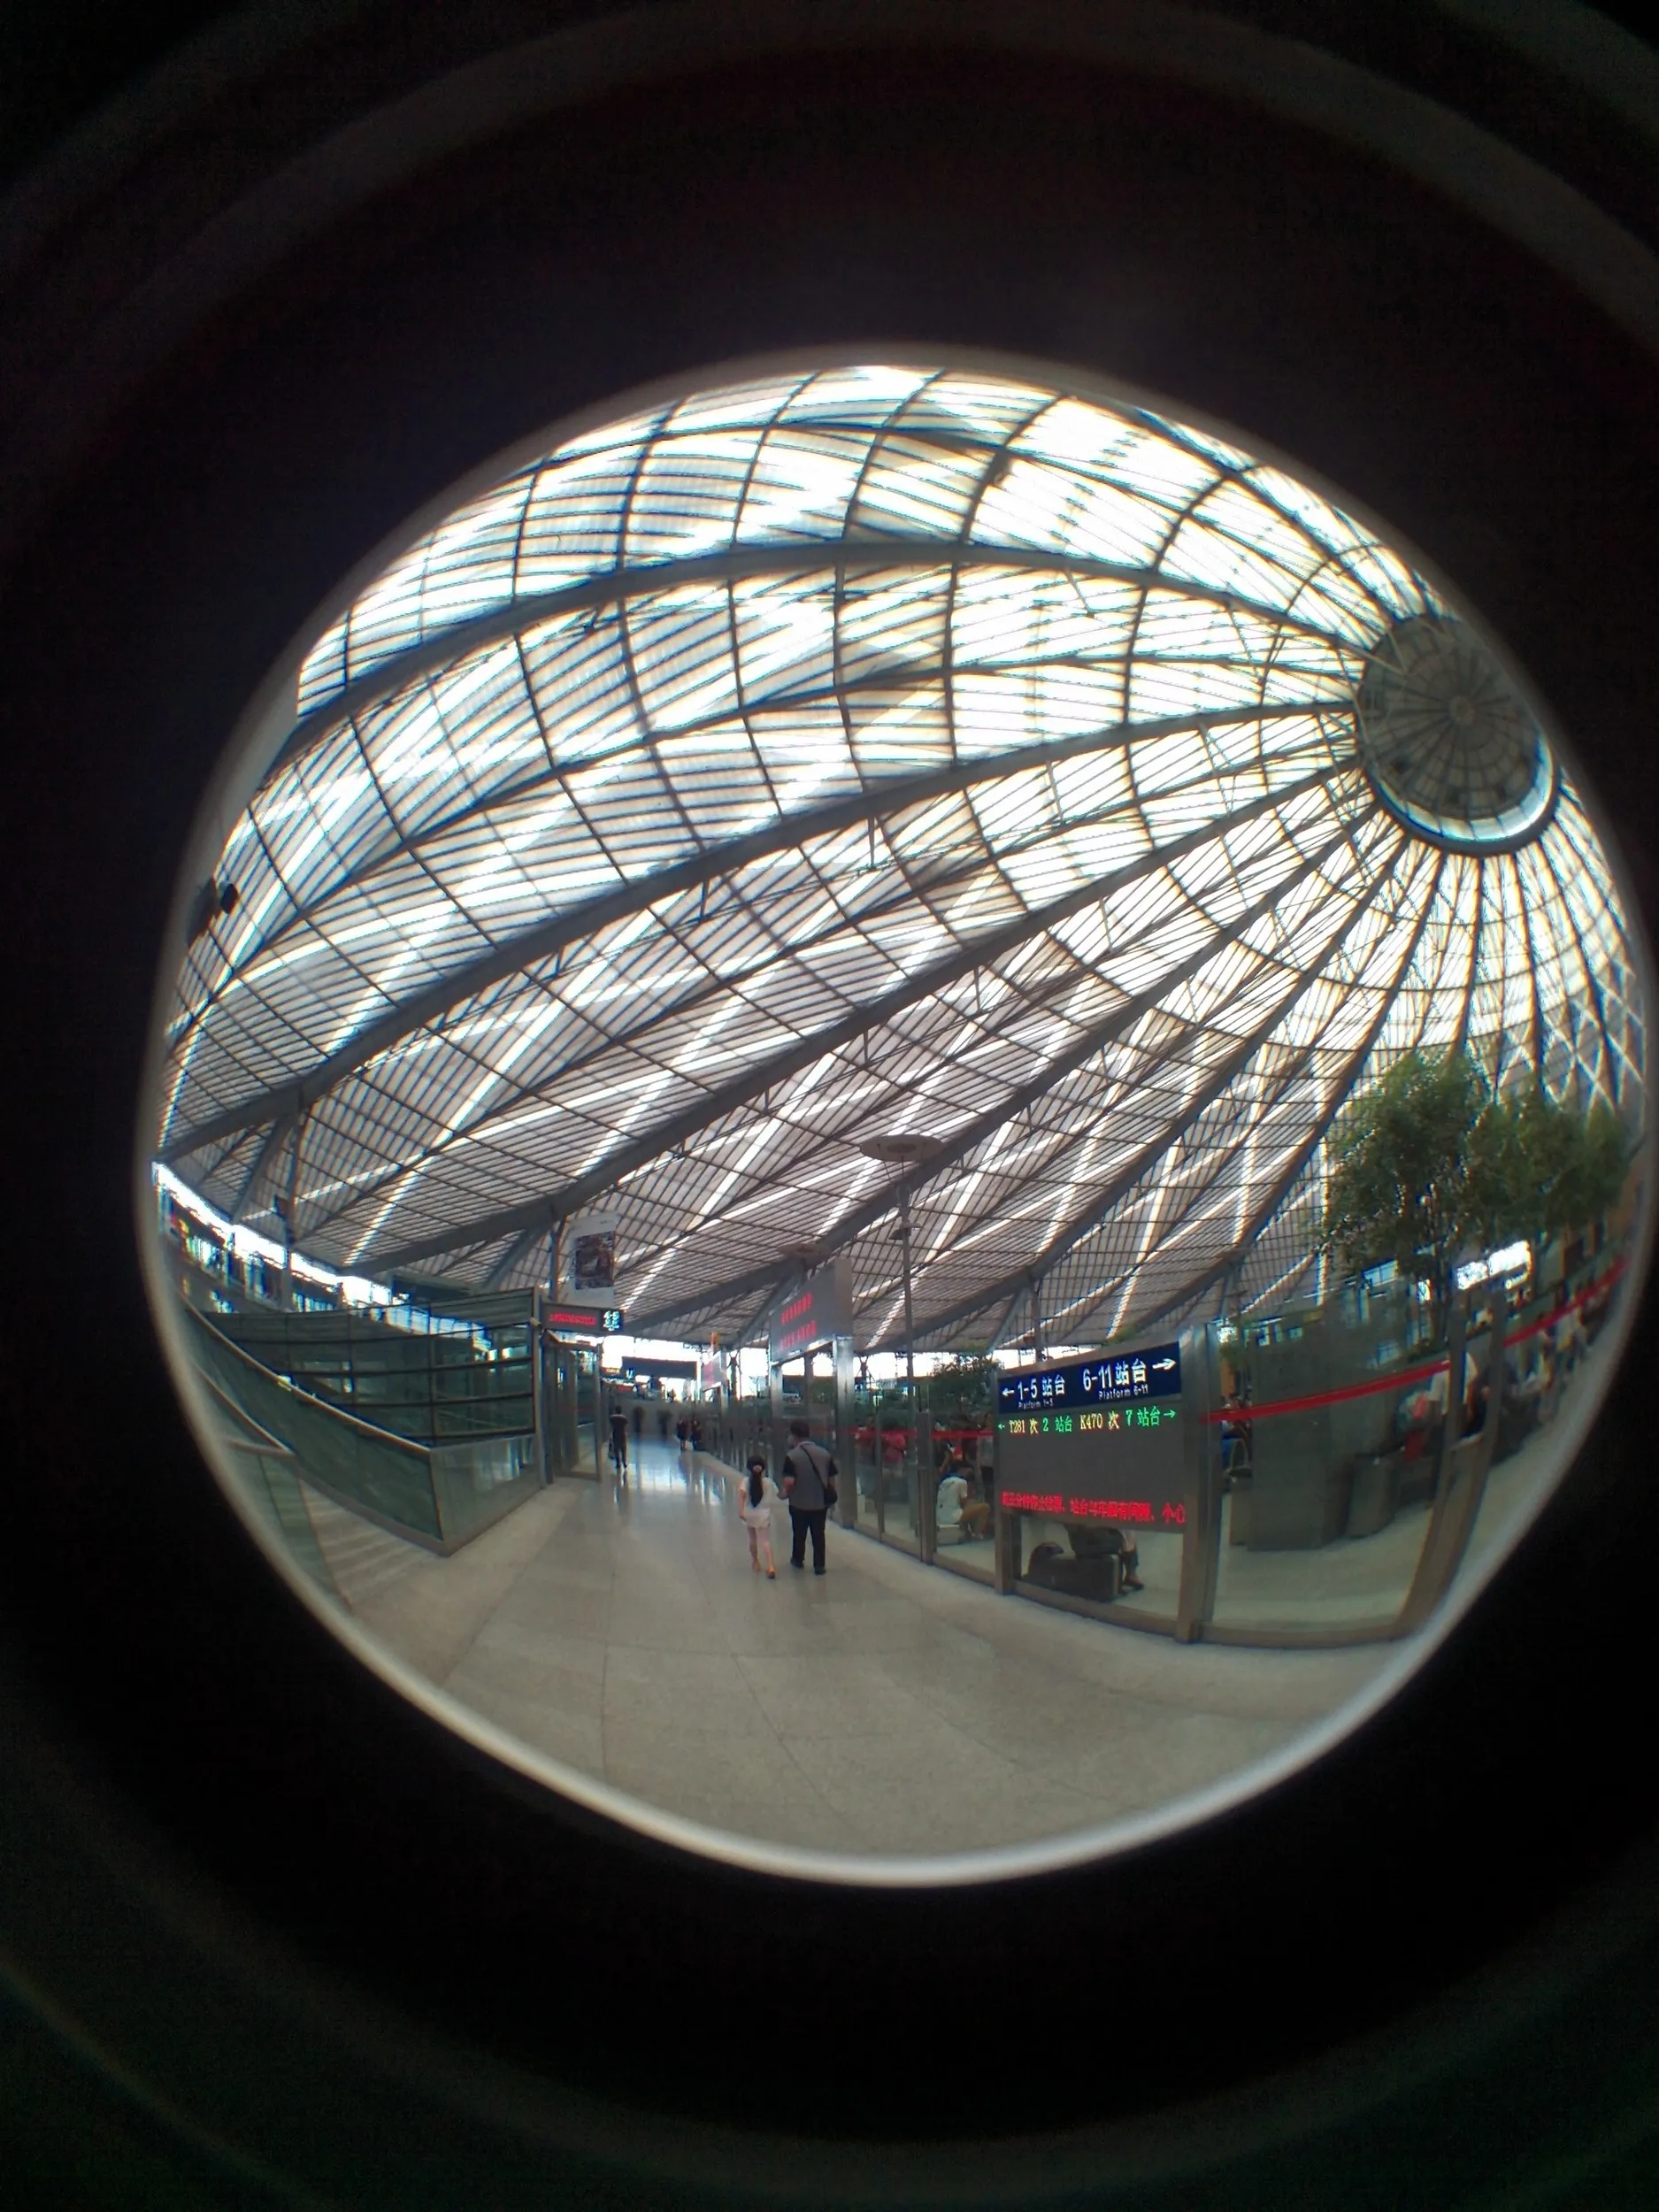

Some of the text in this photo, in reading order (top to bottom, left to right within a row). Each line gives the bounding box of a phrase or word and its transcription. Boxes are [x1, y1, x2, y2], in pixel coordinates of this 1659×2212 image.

[1017, 1374, 1065, 1401] 1-5站台
[1082, 1358, 1147, 1392] 6-11站台
[1099, 1383, 1148, 1400] Platform 6-11
[1042, 1417, 1049, 1432] 2
[1055, 1416, 1072, 1433] 站台
[1079, 1405, 1161, 1431] K470 次 7 站台
